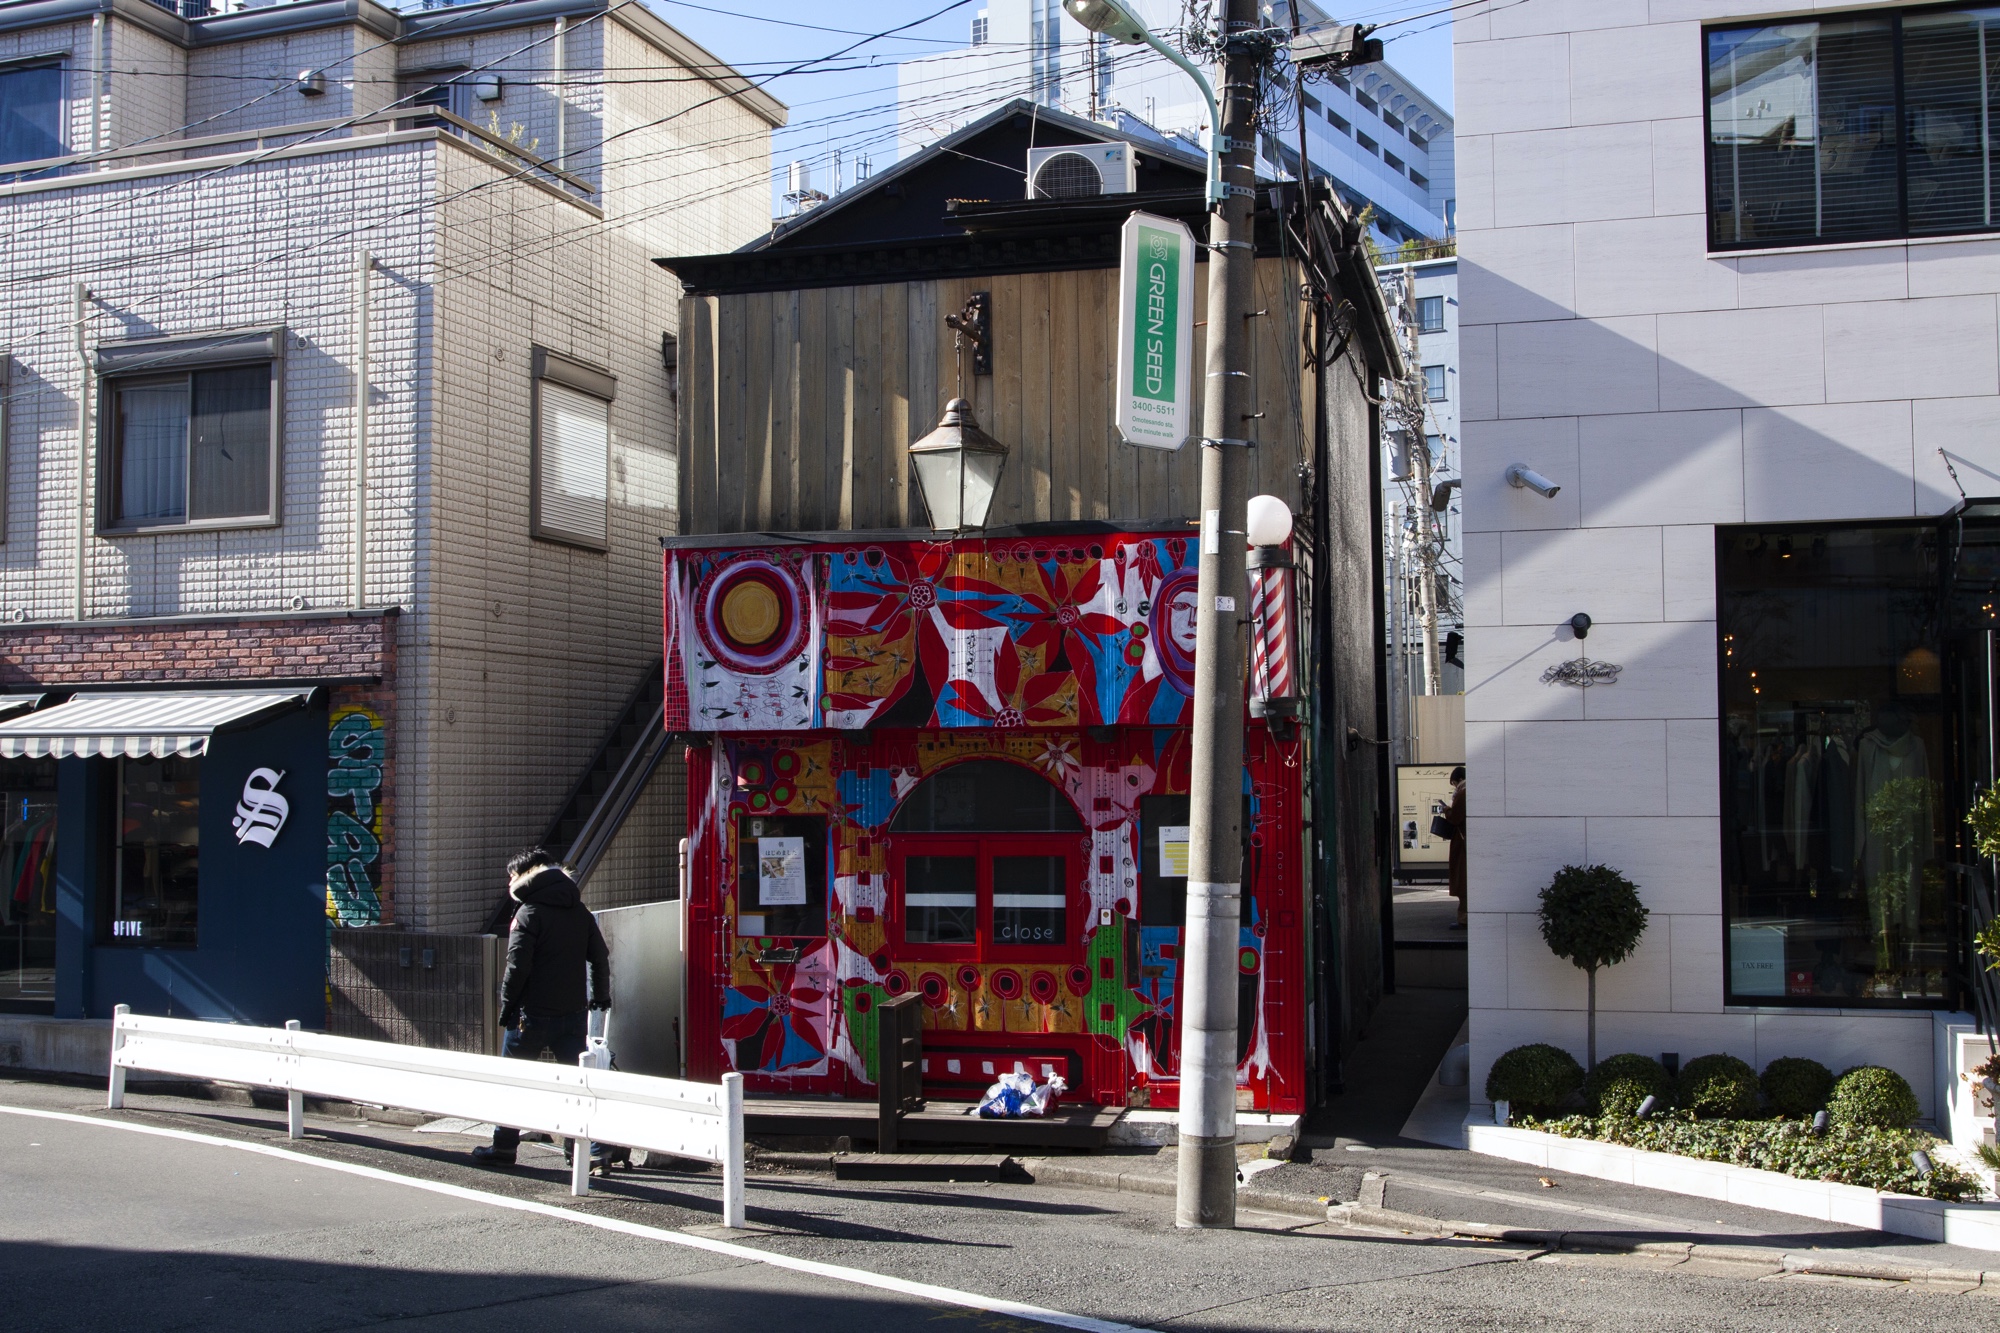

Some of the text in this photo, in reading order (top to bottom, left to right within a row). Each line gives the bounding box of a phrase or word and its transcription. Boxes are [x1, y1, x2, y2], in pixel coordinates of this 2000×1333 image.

[1146, 262, 1166, 395] GREEN SEED
[1132, 400, 1175, 416] 3400-5511
[1132, 415, 1164, 427] Omotesando
[1132, 425, 1143, 433] One
[1143, 428, 1161, 437] minute
[113, 920, 142, 936] 9FIVE
[1002, 923, 1053, 940] close
[1741, 961, 1755, 969] TAX
